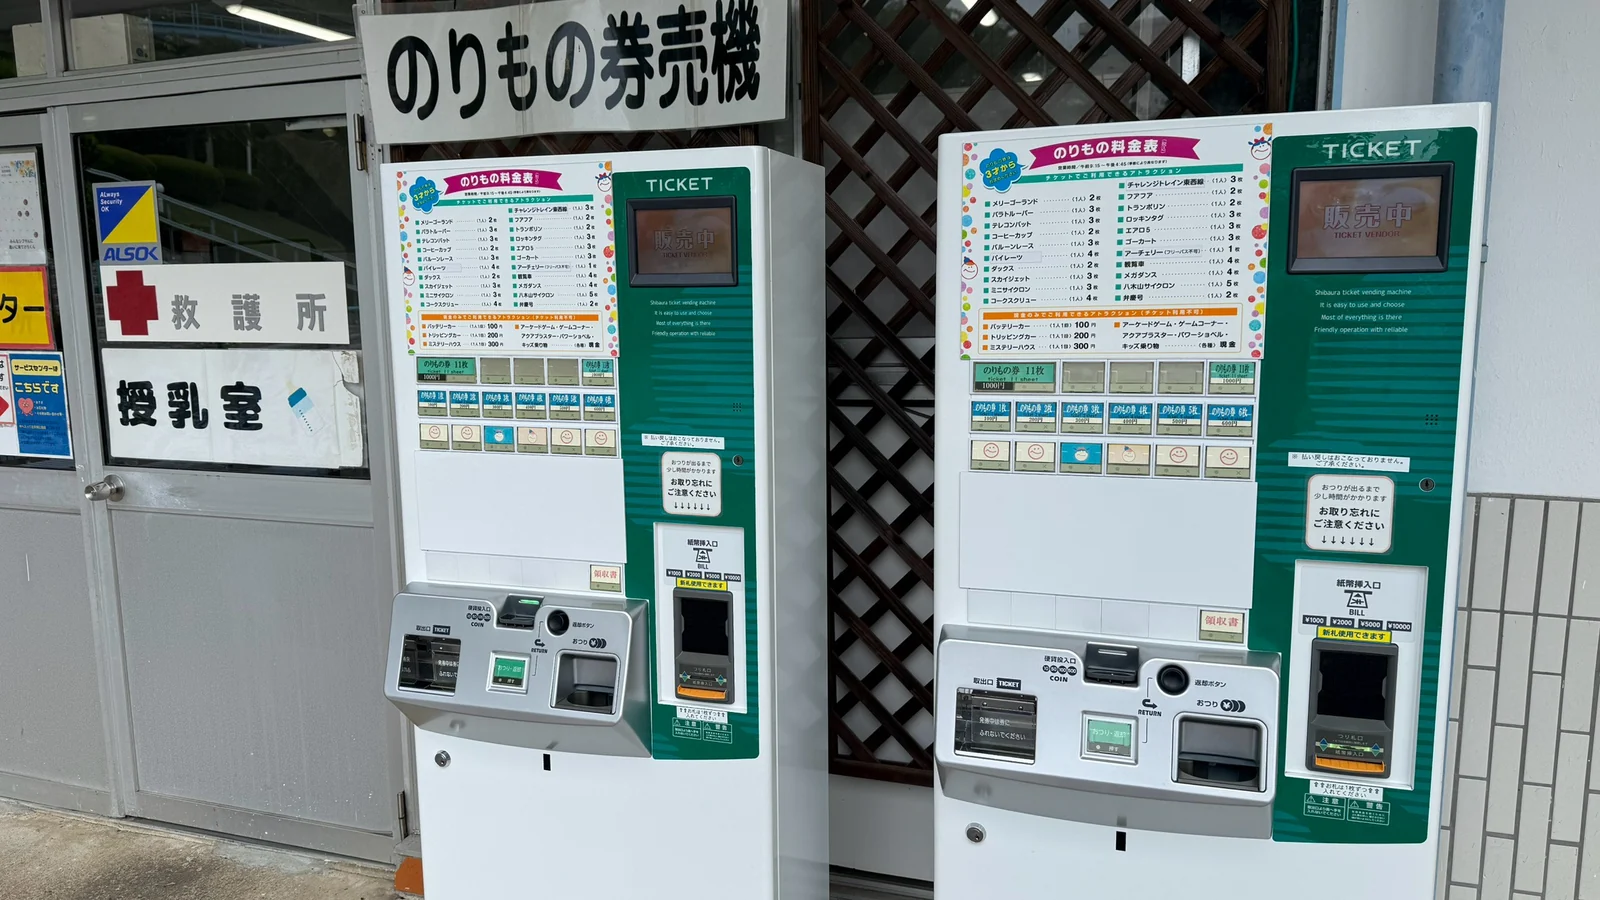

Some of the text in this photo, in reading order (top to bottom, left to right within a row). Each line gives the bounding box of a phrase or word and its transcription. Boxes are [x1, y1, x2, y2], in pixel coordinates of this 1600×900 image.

[387, 0, 761, 121] のりもの券売機
[1054, 139, 1158, 160] のりもの料金表
[1323, 140, 1422, 159] TICKET
[461, 172, 533, 187] のりもの料金表
[1127, 178, 1204, 188] チャレンジトレイン東西線
[646, 177, 713, 192] TICKET
[992, 198, 1038, 207] メリーゴーランド
[1323, 203, 1413, 230] 販売中
[992, 232, 1033, 240] コーヒーカップ
[1334, 231, 1362, 239] TICKET
[654, 229, 715, 251] 販売中
[103, 246, 158, 261] ALSOK
[1123, 282, 1175, 290] 八木山サイクロン
[0, 293, 44, 323] ター
[171, 293, 326, 332] 救護所
[1345, 314, 1377, 322] everything
[1074, 321, 1096, 329] 100円
[1314, 326, 1338, 334] Friendly
[1073, 332, 1096, 340] 200円
[983, 366, 1045, 376] のりもの券 11枚
[1215, 364, 1237, 373] のりもの券
[15, 381, 59, 394] こちらです
[117, 380, 263, 431] 授乳室
[1212, 408, 1236, 417] のりもの券
[666, 467, 716, 475] 少し時間がかかります
[671, 478, 712, 487] お取り忘れに
[667, 488, 717, 498] ご注意ください
[1322, 484, 1380, 493] おつりが出るまで
[1314, 493, 1387, 502] 少し時間がかかります
[1319, 507, 1380, 517] お取り忘れに
[1314, 519, 1385, 531] ご注意ください
[687, 539, 718, 547] 紙幣挿入口
[594, 570, 617, 579] 領収書
[680, 580, 723, 588] 新札使用できます
[1336, 579, 1381, 589] 紙幣挿入口
[1205, 615, 1239, 627] 領収書
[1323, 629, 1386, 640] 新札使用できます
[973, 677, 1019, 688] 取出口 TICKET
[1050, 675, 1068, 683] COIN
[1194, 679, 1227, 688] 返却ボタン
[1197, 700, 1218, 708] おつり
[1138, 709, 1161, 717] RETURN
[979, 730, 1026, 740] ふれないでください
[1323, 789, 1367, 798] 入れてください
[1322, 797, 1339, 805] 注意
[1366, 802, 1383, 810] 警告
